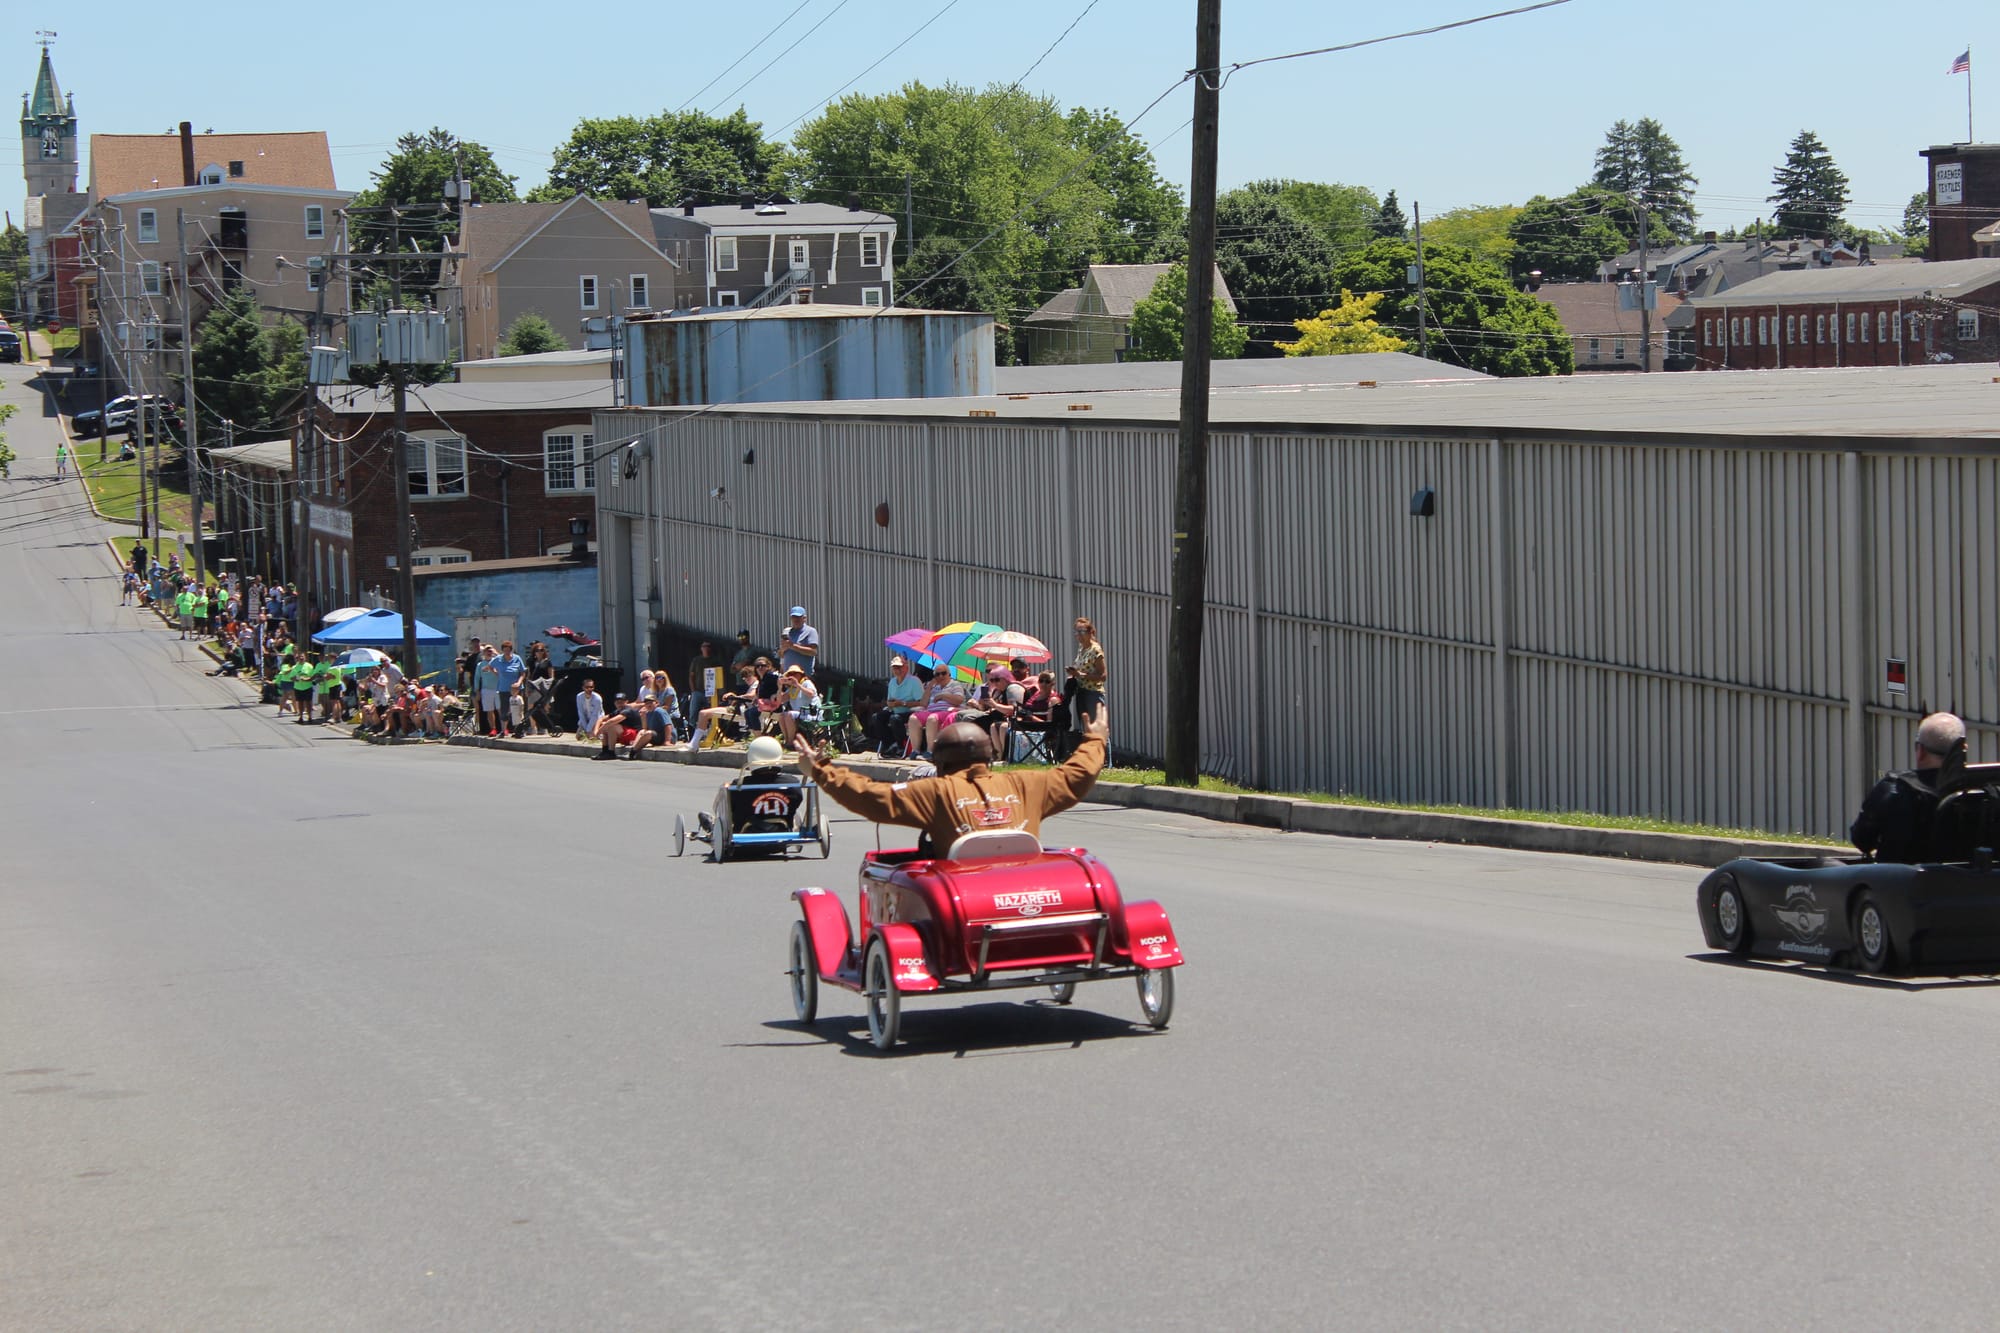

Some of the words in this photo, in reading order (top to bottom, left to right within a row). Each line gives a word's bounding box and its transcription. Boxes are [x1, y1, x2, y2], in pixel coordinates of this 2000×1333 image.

[1937, 169, 1961, 180] KRAEMER
[1938, 182, 1961, 193] TEXTILES
[983, 810, 1004, 821] Ford
[994, 892, 1062, 907] NAZARETH
[1140, 935, 1168, 946] KOCH
[1777, 941, 1831, 956] Automotive
[898, 958, 926, 966] KOCH
